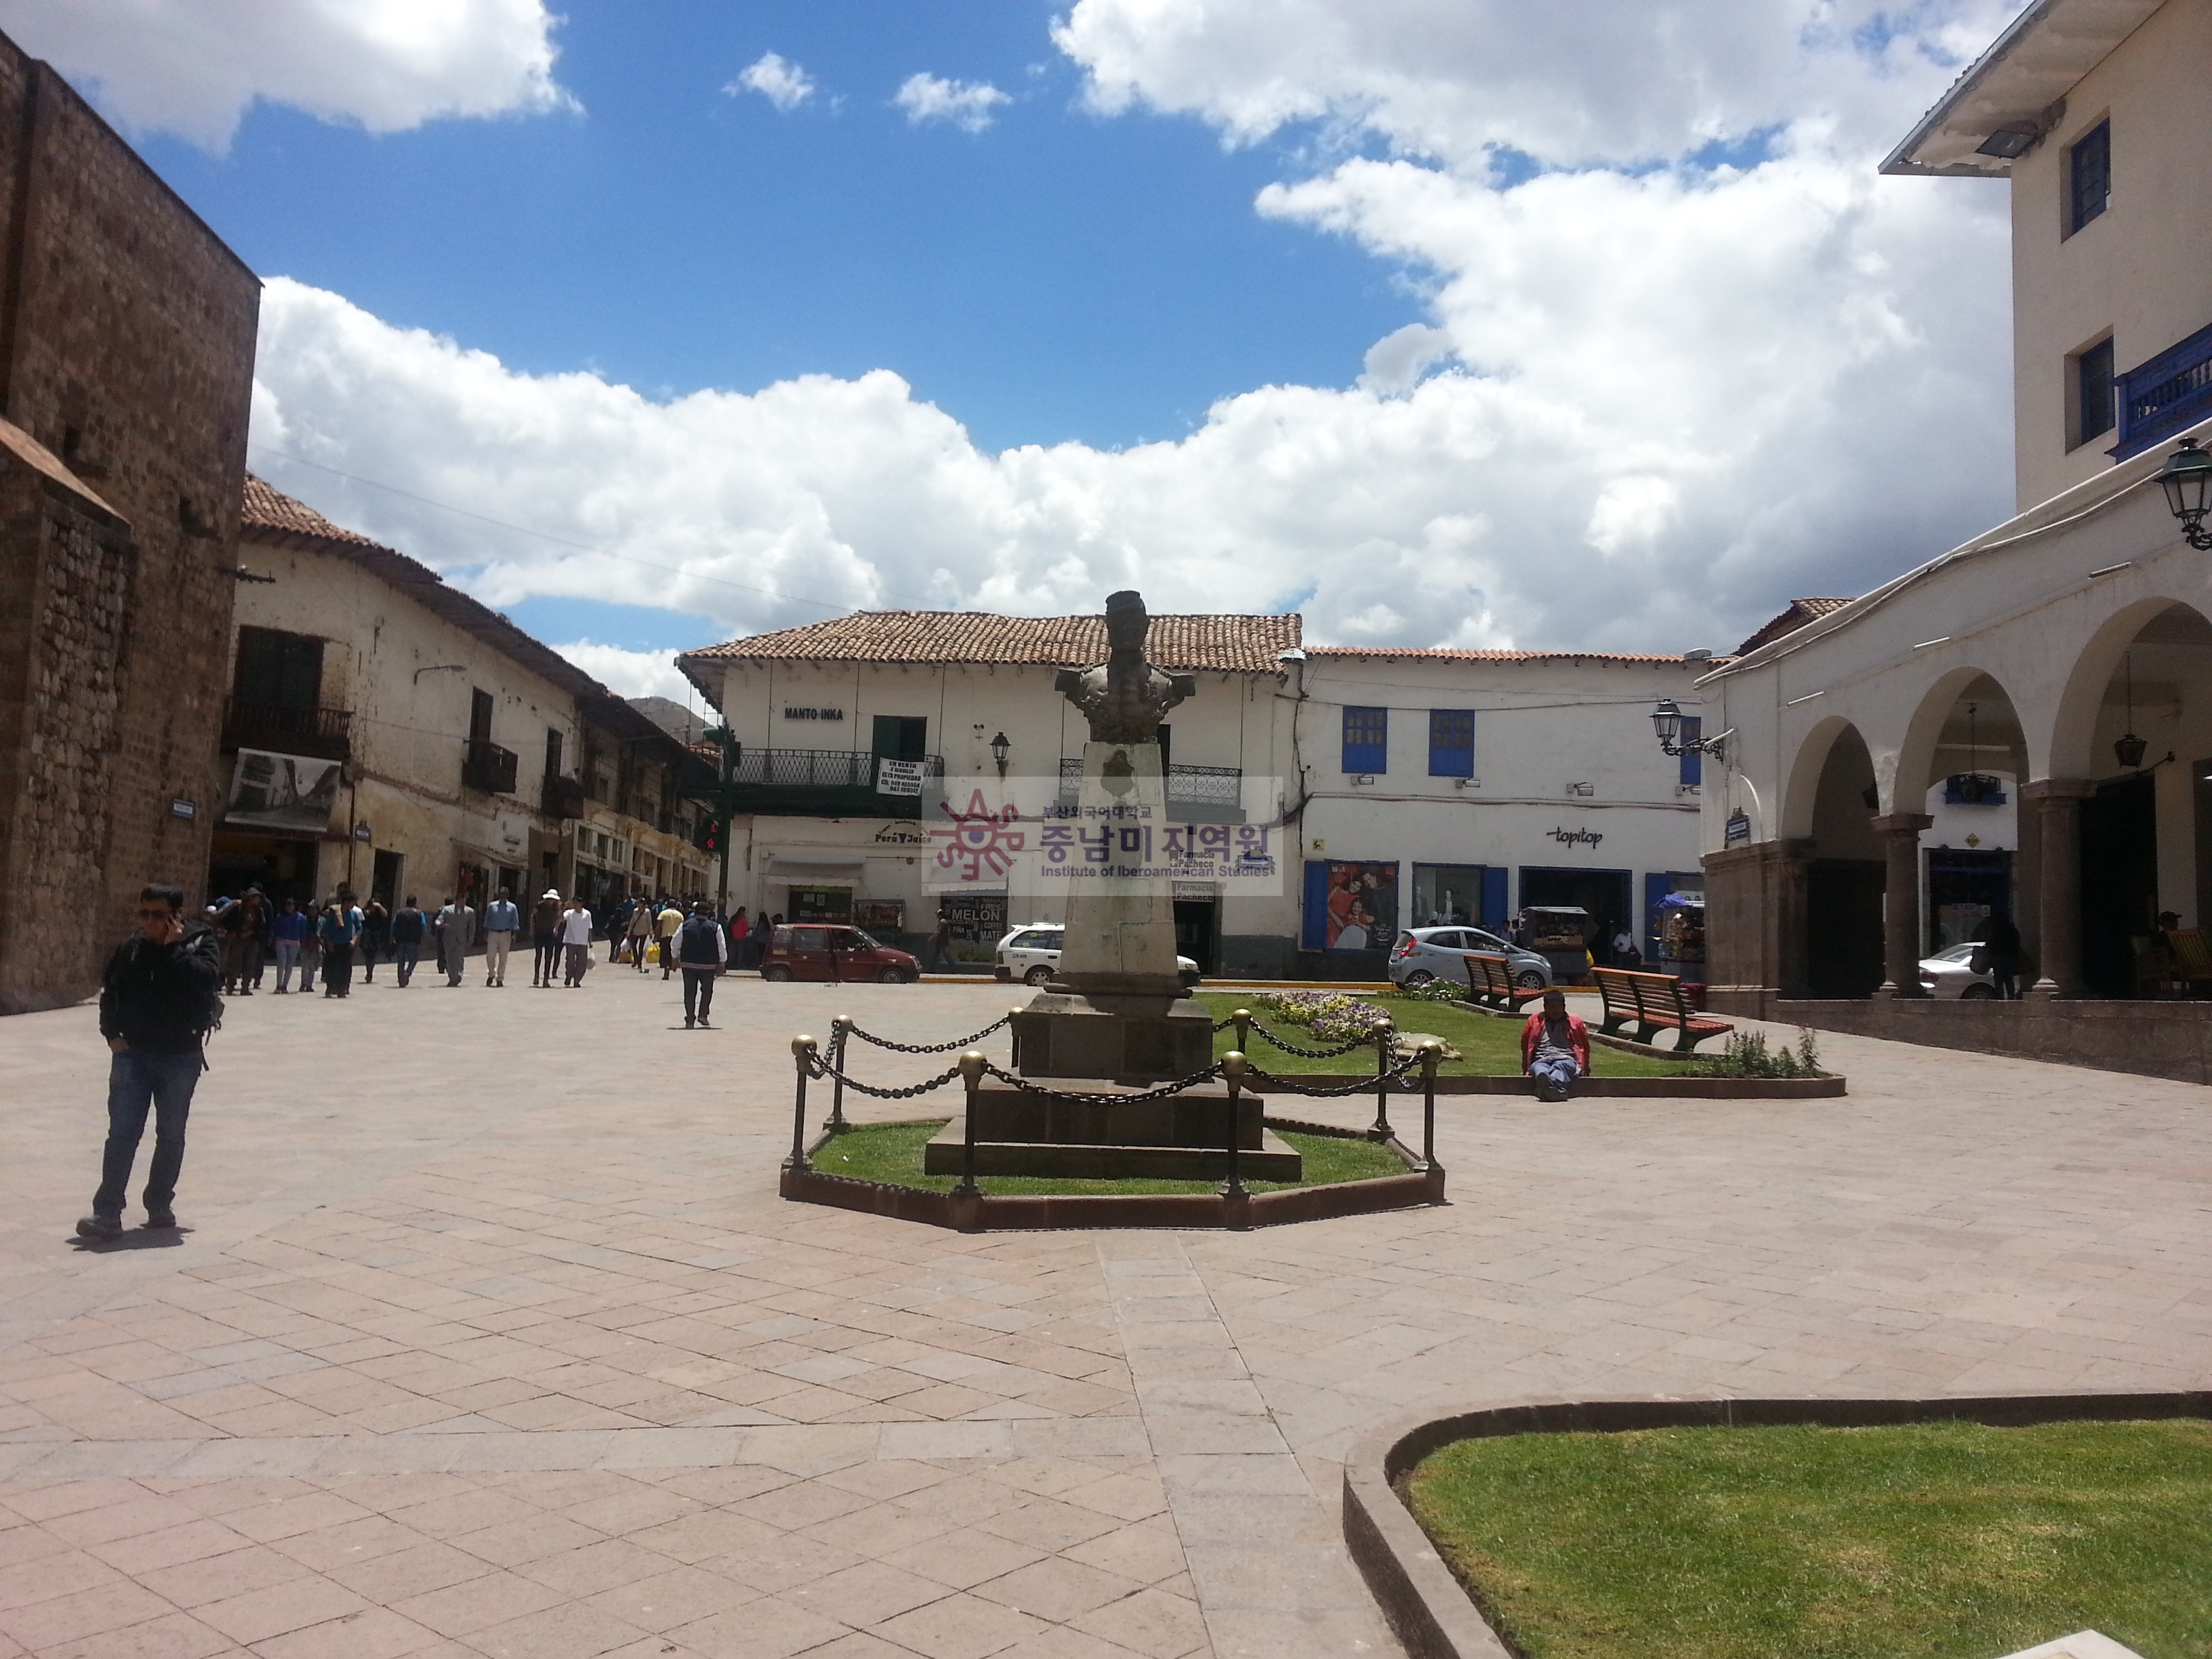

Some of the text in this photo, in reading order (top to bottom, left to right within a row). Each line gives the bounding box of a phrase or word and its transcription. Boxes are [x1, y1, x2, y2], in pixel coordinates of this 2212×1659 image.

[785, 708, 843, 720] MANTO INKA
[875, 832, 932, 843] Perú Juice
[1546, 826, 1603, 849] topitop
[1179, 850, 1215, 859] Farmacia
[1179, 859, 1214, 868] Pacheco
[1176, 883, 1213, 892] Farmacia
[1176, 893, 1213, 901] Pacheco
[951, 909, 1000, 921] MELON
[981, 930, 1002, 941] MATE
